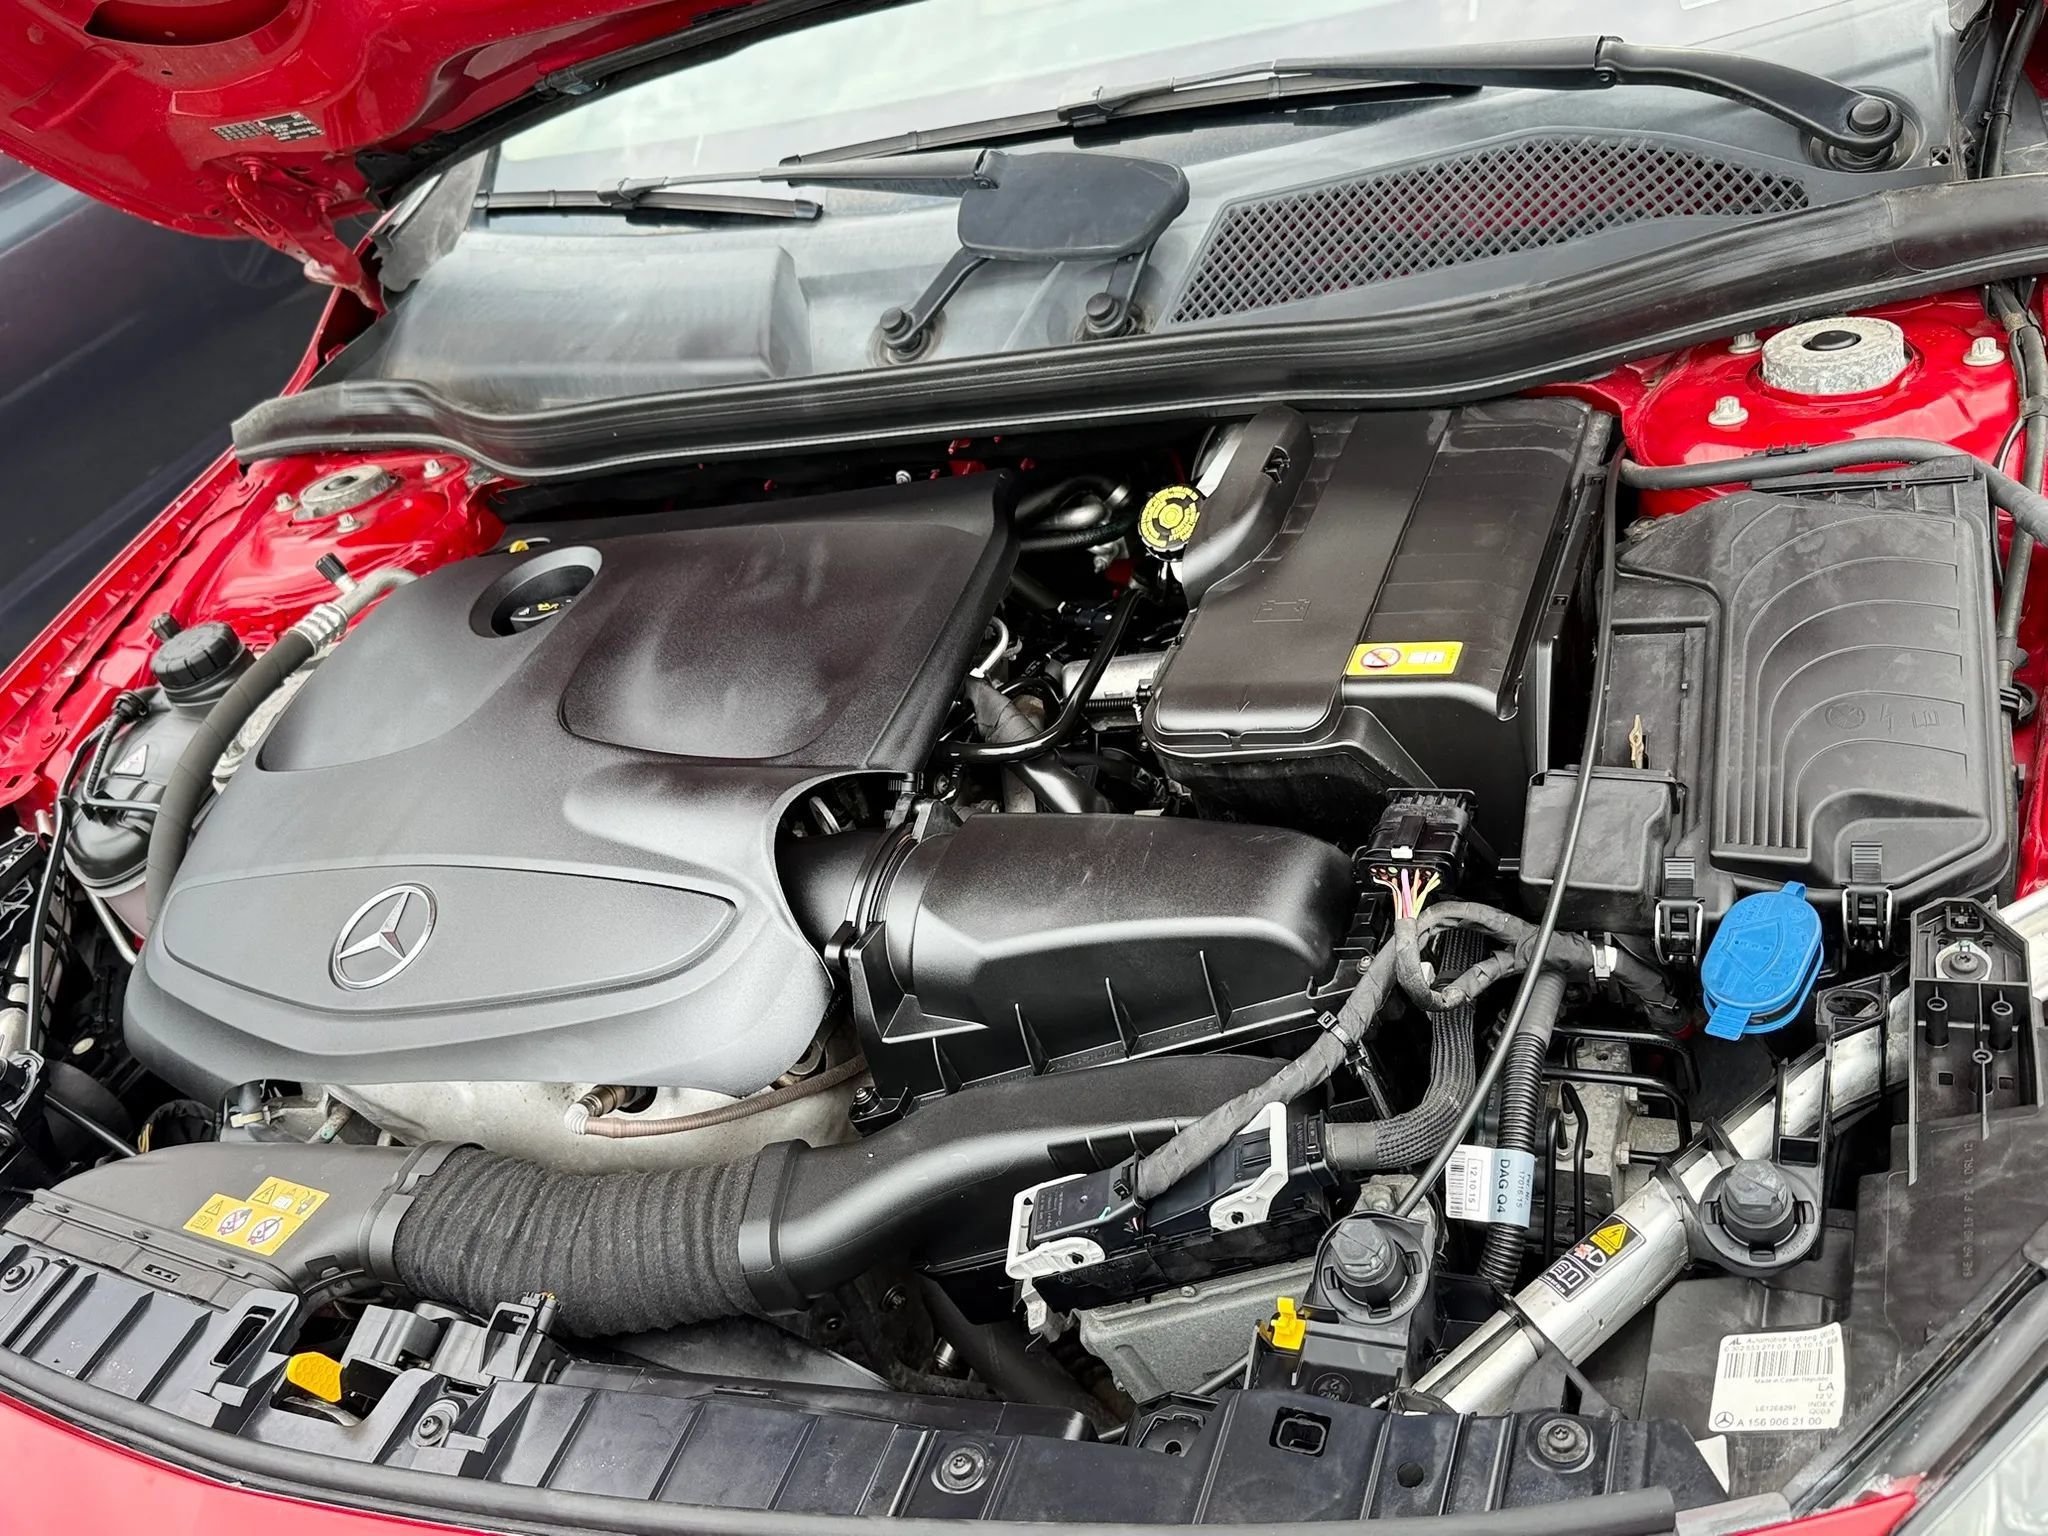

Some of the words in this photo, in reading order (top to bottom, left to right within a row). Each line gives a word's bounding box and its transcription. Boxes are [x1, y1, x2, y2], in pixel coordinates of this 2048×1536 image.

[1499, 1159, 1510, 1189] DAG
[1496, 1194, 1507, 1213] Q4
[1818, 1382, 1834, 1391] LA
[1736, 1419, 1745, 1427] A
[1749, 1418, 1766, 1427] 156
[1769, 1417, 1789, 1426] 906
[1792, 1417, 1804, 1426] 21
[1808, 1416, 1822, 1425] 00
